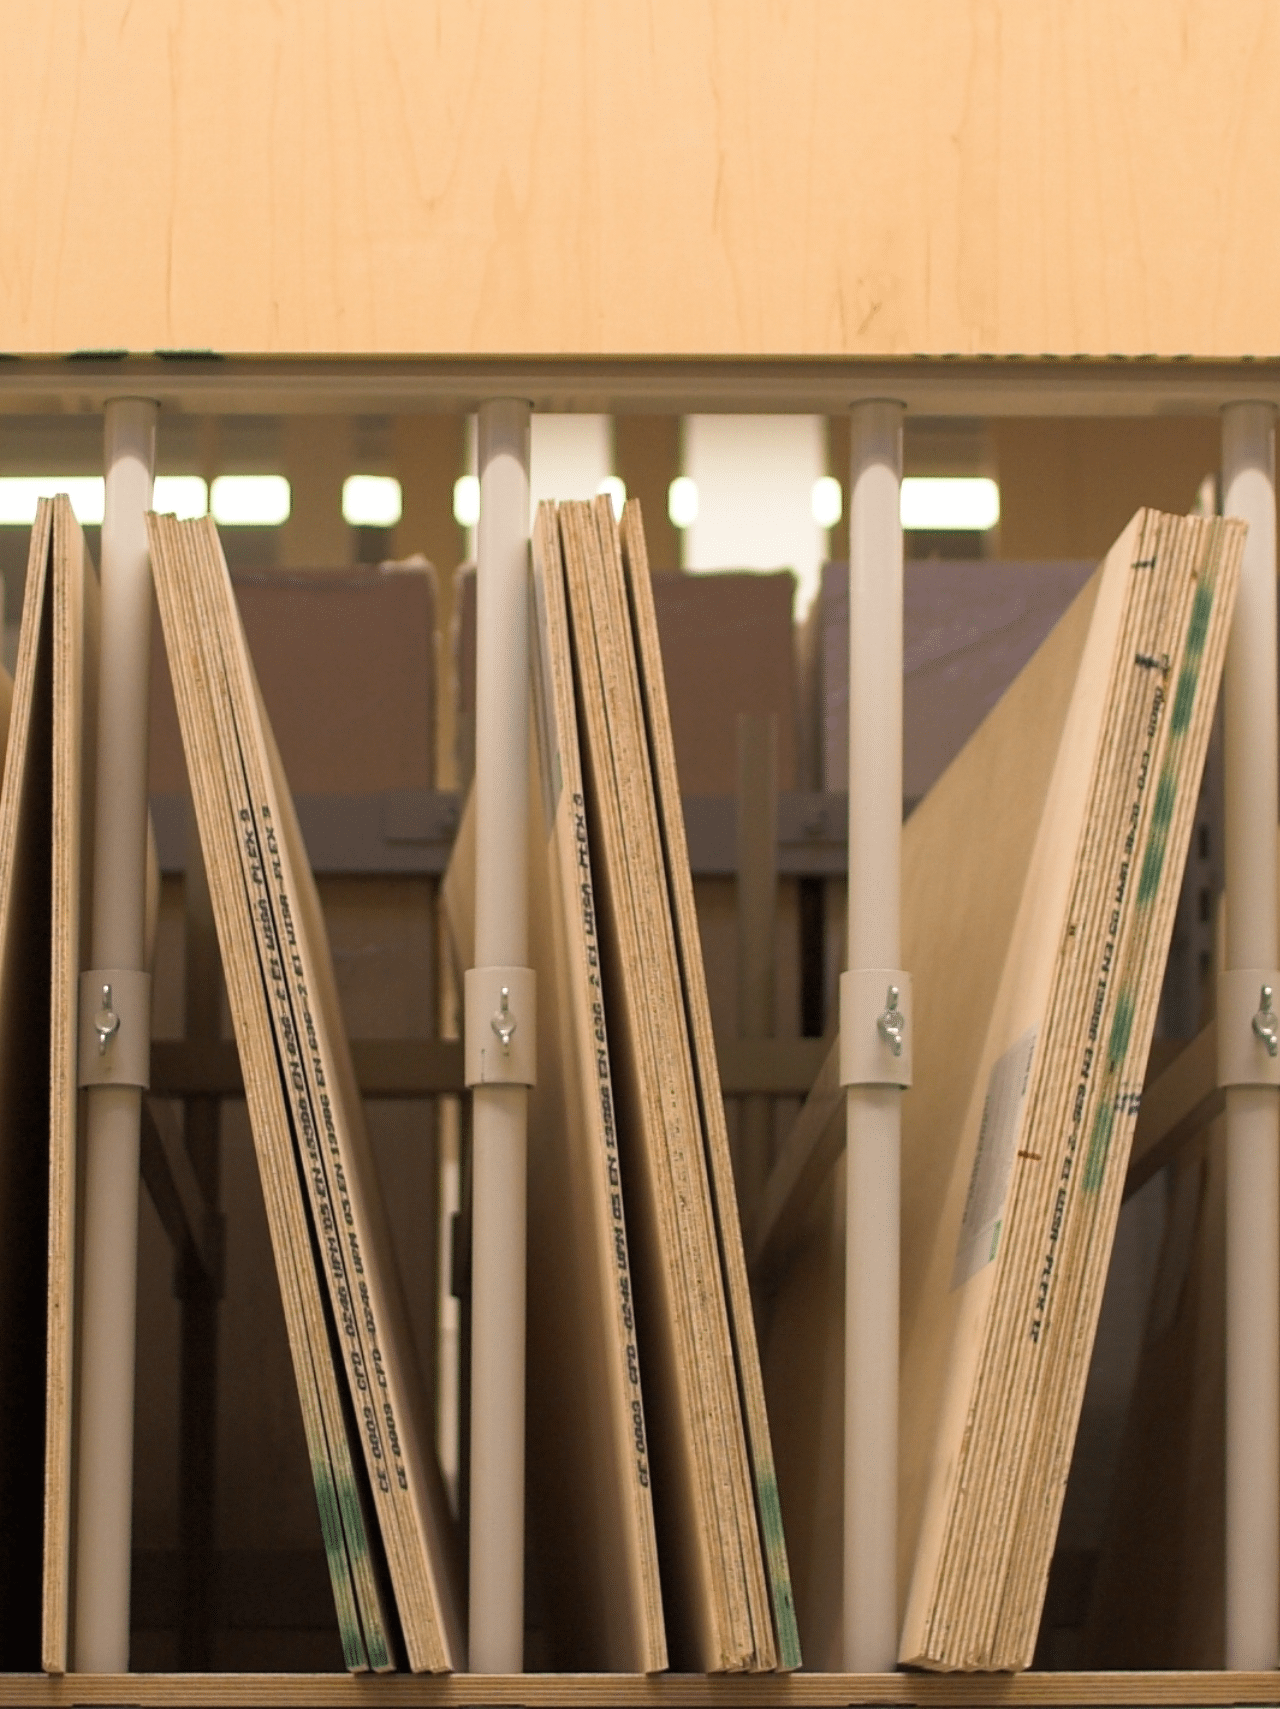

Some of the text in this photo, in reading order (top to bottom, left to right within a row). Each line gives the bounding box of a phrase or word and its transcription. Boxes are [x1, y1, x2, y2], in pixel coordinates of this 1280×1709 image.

[289, 1060, 303, 1092] EN
[312, 1057, 325, 1087] EN
[597, 1048, 607, 1079] EN
[312, 1166, 325, 1198] EN
[334, 1162, 346, 1193] EN
[607, 1154, 618, 1186] EN
[327, 1236, 342, 1278] UPM
[348, 1231, 363, 1274] UPM
[614, 1226, 626, 1270] UPM
[376, 1465, 388, 1493] CE
[395, 1463, 407, 1490] CE
[637, 1458, 647, 1488] CE
